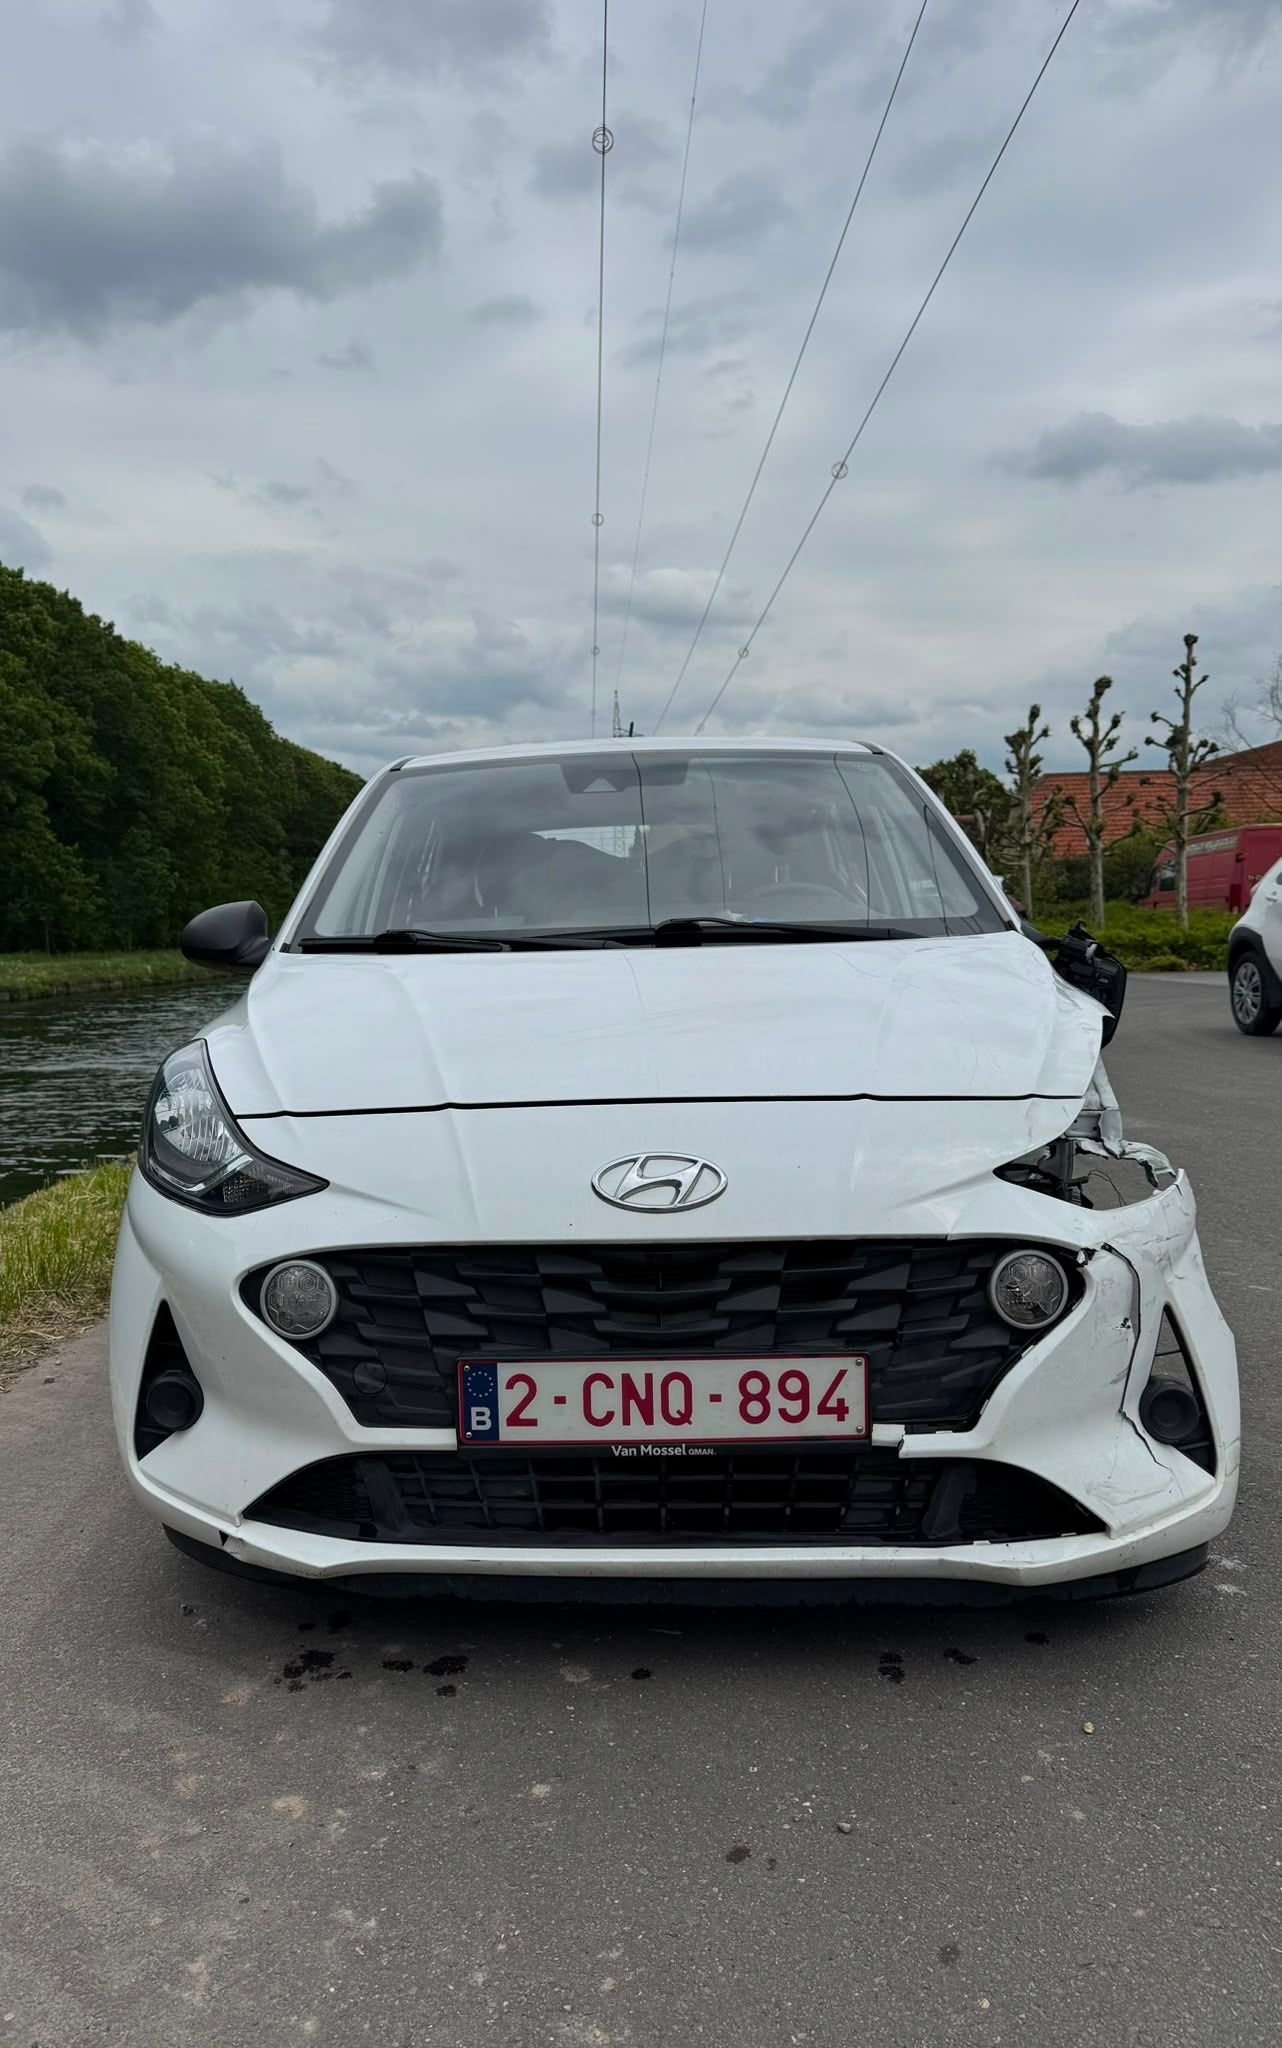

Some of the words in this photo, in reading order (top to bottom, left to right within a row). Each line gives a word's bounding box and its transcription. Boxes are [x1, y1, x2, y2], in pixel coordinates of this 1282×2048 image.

[471, 1407, 492, 1431] B
[611, 1445, 637, 1457] Van
[640, 1443, 687, 1456] Mossel
